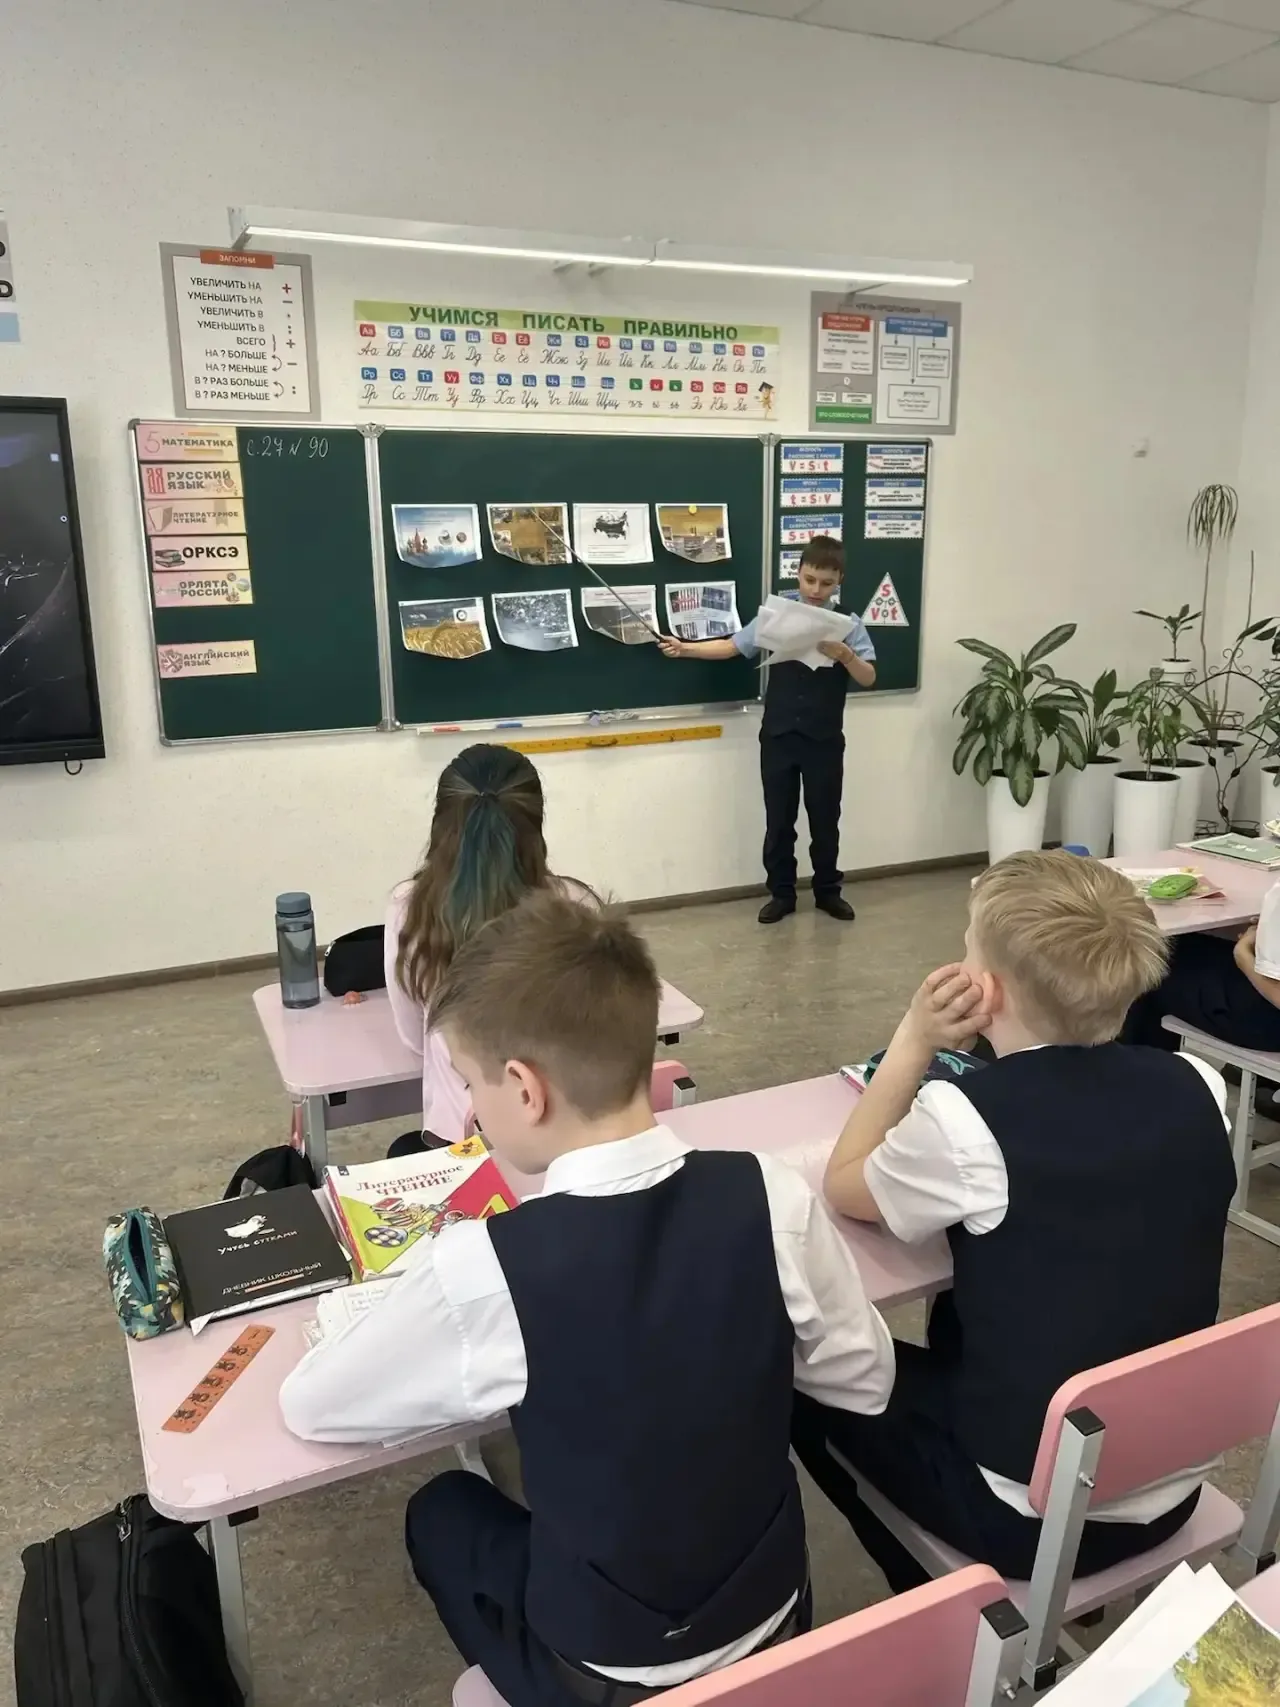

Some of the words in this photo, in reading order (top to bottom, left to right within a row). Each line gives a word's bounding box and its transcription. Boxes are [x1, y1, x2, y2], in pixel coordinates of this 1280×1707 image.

[219, 254, 256, 264] ЗАПОМНИ
[190, 277, 246, 289] УВЕЛИЧИТЬ
[248, 282, 262, 290] НА
[187, 291, 248, 304] УМЕНЬШИТЬ
[249, 296, 263, 305] НА
[200, 306, 255, 318] УВЕЛИЧИТЬ
[257, 310, 264, 318] В
[197, 320, 257, 332] УМЕНЬШИТЬ
[259, 322, 265, 332] В
[409, 306, 498, 327] УЧИМСЯ
[522, 313, 605, 333] ПИСАТЬ
[624, 320, 738, 340] ПРАВИЛЬНО
[236, 336, 266, 346] ВСЕГО
[205, 348, 219, 357] НА
[220, 349, 226, 358] ?
[227, 350, 267, 360] БОЛЬШЕ
[358, 341, 380, 356] Аа
[387, 342, 408, 357] Бб
[442, 345, 456, 360] Гг
[465, 346, 482, 367] Дд
[205, 363, 220, 372] НА
[222, 364, 227, 372] ?
[228, 364, 268, 374] МЕНЬШЕ
[194, 376, 201, 385] В
[203, 377, 208, 385] ?
[210, 377, 229, 386] РАЗ
[230, 378, 269, 388] БОЛЬШЕ
[195, 390, 201, 399] В
[203, 391, 208, 399] ?
[210, 391, 229, 400] РАЗ
[230, 392, 270, 401] МЕНЬШЕ
[361, 384, 378, 404] Рр
[392, 385, 406, 400] Сс
[412, 386, 439, 402] Тт
[445, 387, 459, 408] Уу
[494, 389, 516, 405] Хх
[522, 390, 539, 408] Цц
[162, 438, 234, 448] МАТЕМАТИКА
[309, 436, 329, 458] 90
[789, 461, 796, 471] V
[808, 460, 815, 471] S
[823, 460, 829, 471] t
[167, 469, 231, 480] РУССКИЙ
[167, 481, 205, 490] ЯЗЫК
[790, 494, 796, 505] t
[810, 494, 817, 504] S
[824, 494, 832, 504] V
[789, 531, 797, 541] S
[182, 547, 239, 558] ОРКСЭ
[180, 580, 229, 589] ОРЛЯТА
[882, 583, 891, 597] S
[180, 588, 229, 597] РОССИИ
[871, 607, 880, 621] V
[891, 606, 898, 621] t
[184, 649, 250, 660] АНГЛИЙСКИЙ
[184, 659, 211, 667] ЯЗЫК
[356, 1165, 464, 1191] Литературное
[376, 1175, 453, 1196] ЧТЕНИЕ
[217, 1242, 250, 1255] Учусь
[253, 1230, 298, 1246] сутками
[222, 1277, 267, 1296] ДНЕВНИК
[267, 1262, 322, 1281] ШКОЛЬНЫЙ
